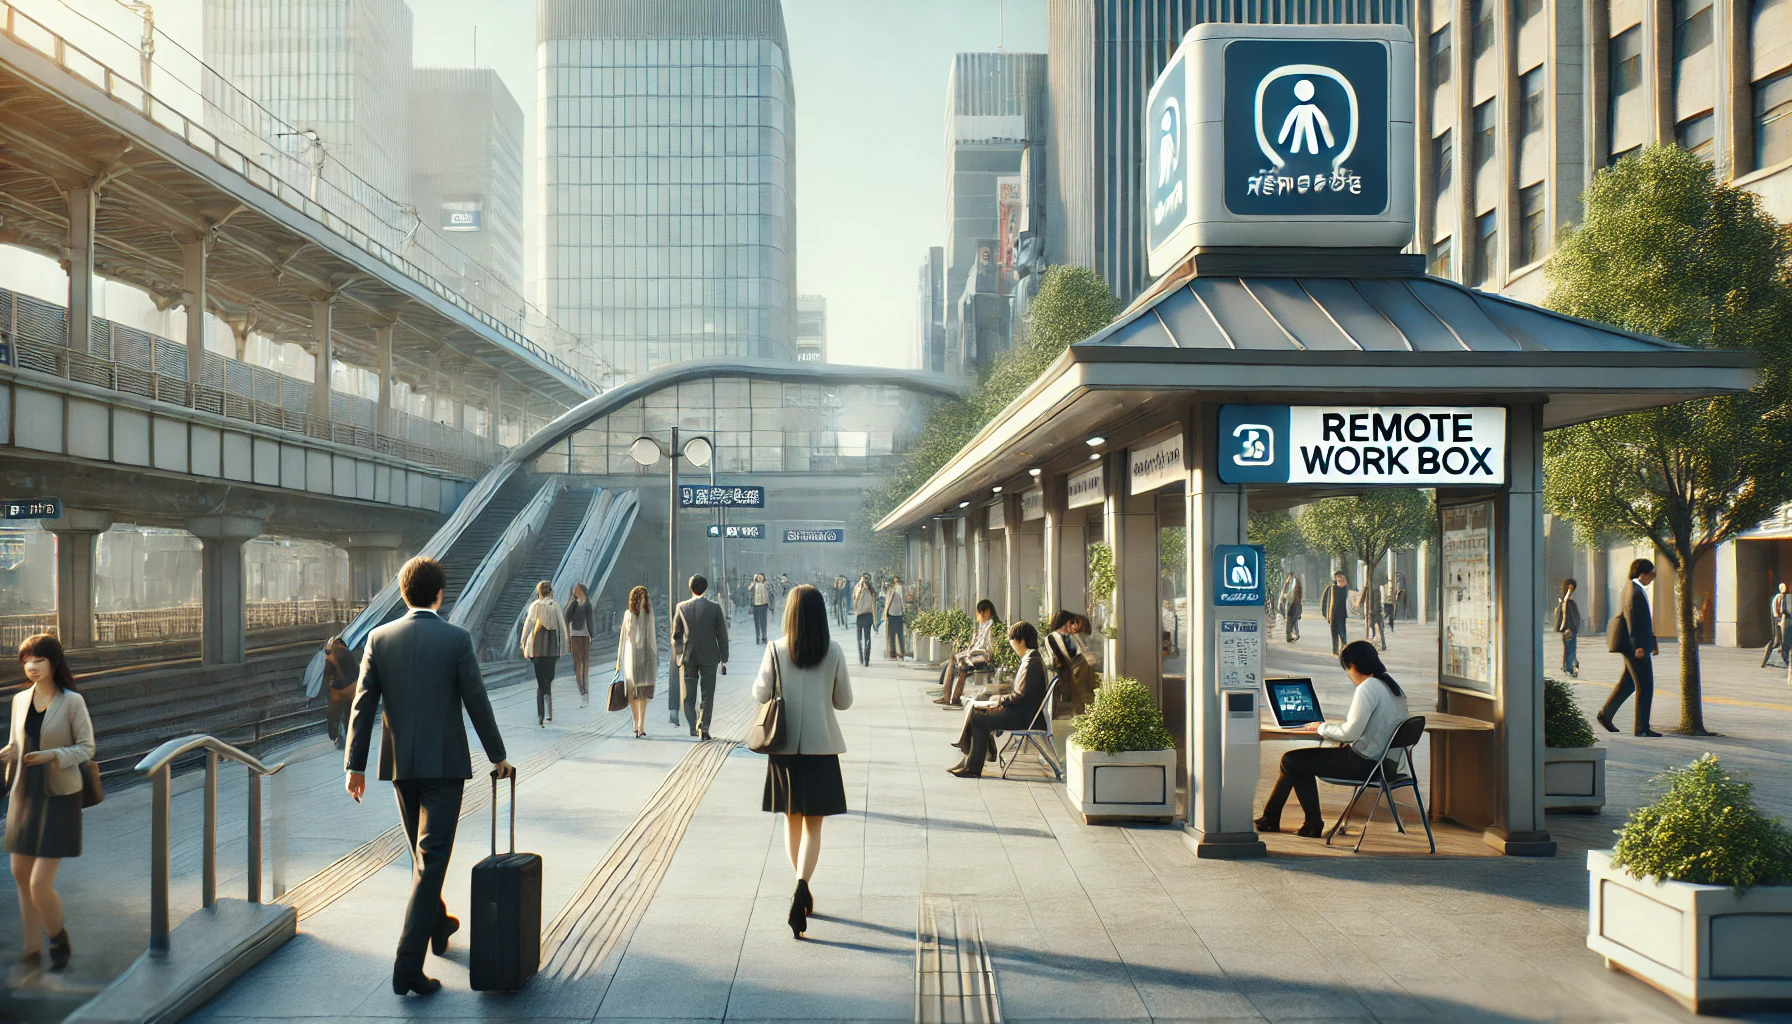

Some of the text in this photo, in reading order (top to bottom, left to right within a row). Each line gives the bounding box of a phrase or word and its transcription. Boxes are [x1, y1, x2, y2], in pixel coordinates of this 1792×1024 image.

[1322, 413, 1473, 442] REMOTE
[1300, 445, 1493, 475] WORK BOX
